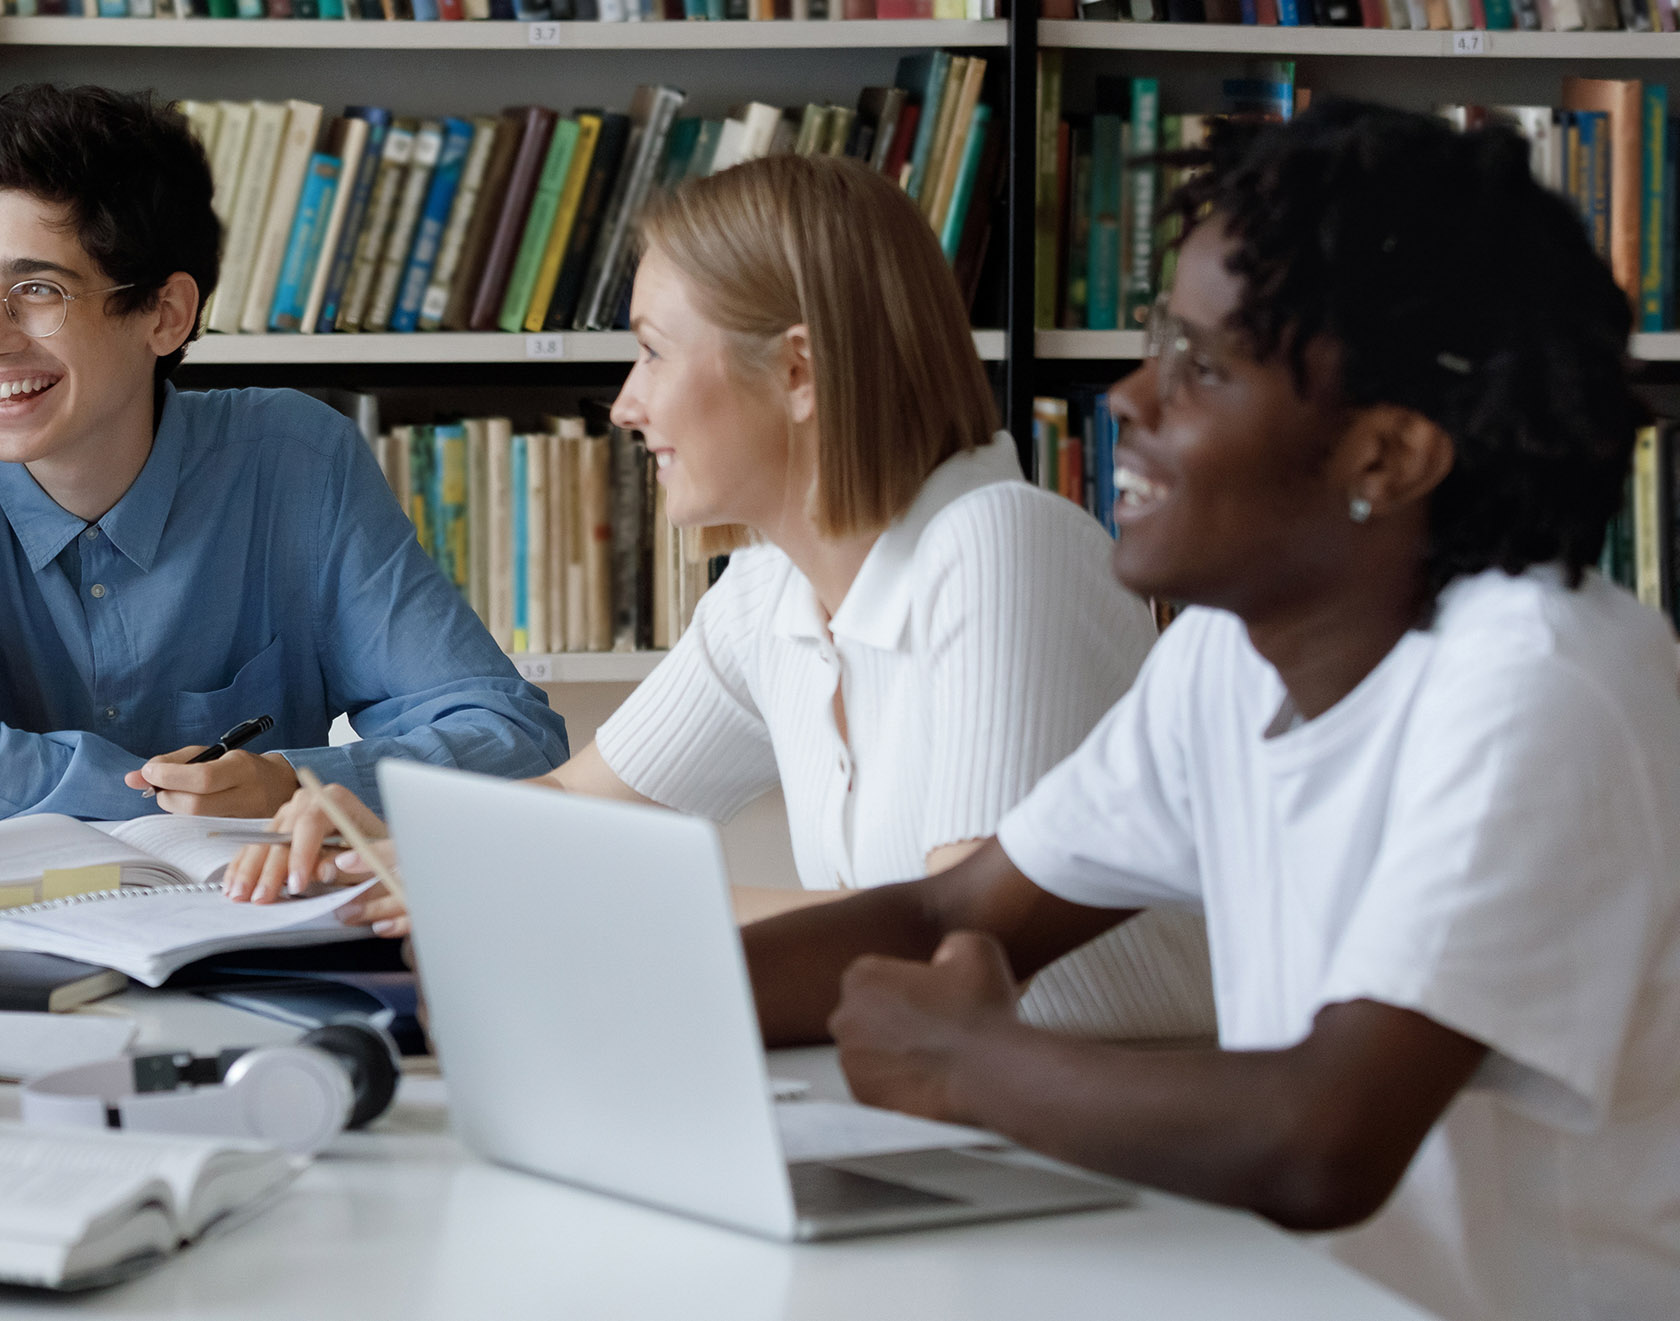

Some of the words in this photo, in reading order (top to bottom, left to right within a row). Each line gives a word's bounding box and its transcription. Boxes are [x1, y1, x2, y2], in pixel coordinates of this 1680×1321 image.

[535, 27, 556, 41] 3.7
[1457, 37, 1479, 50] 4.7
[534, 340, 557, 354] 3.8
[524, 664, 546, 678] 3.9
